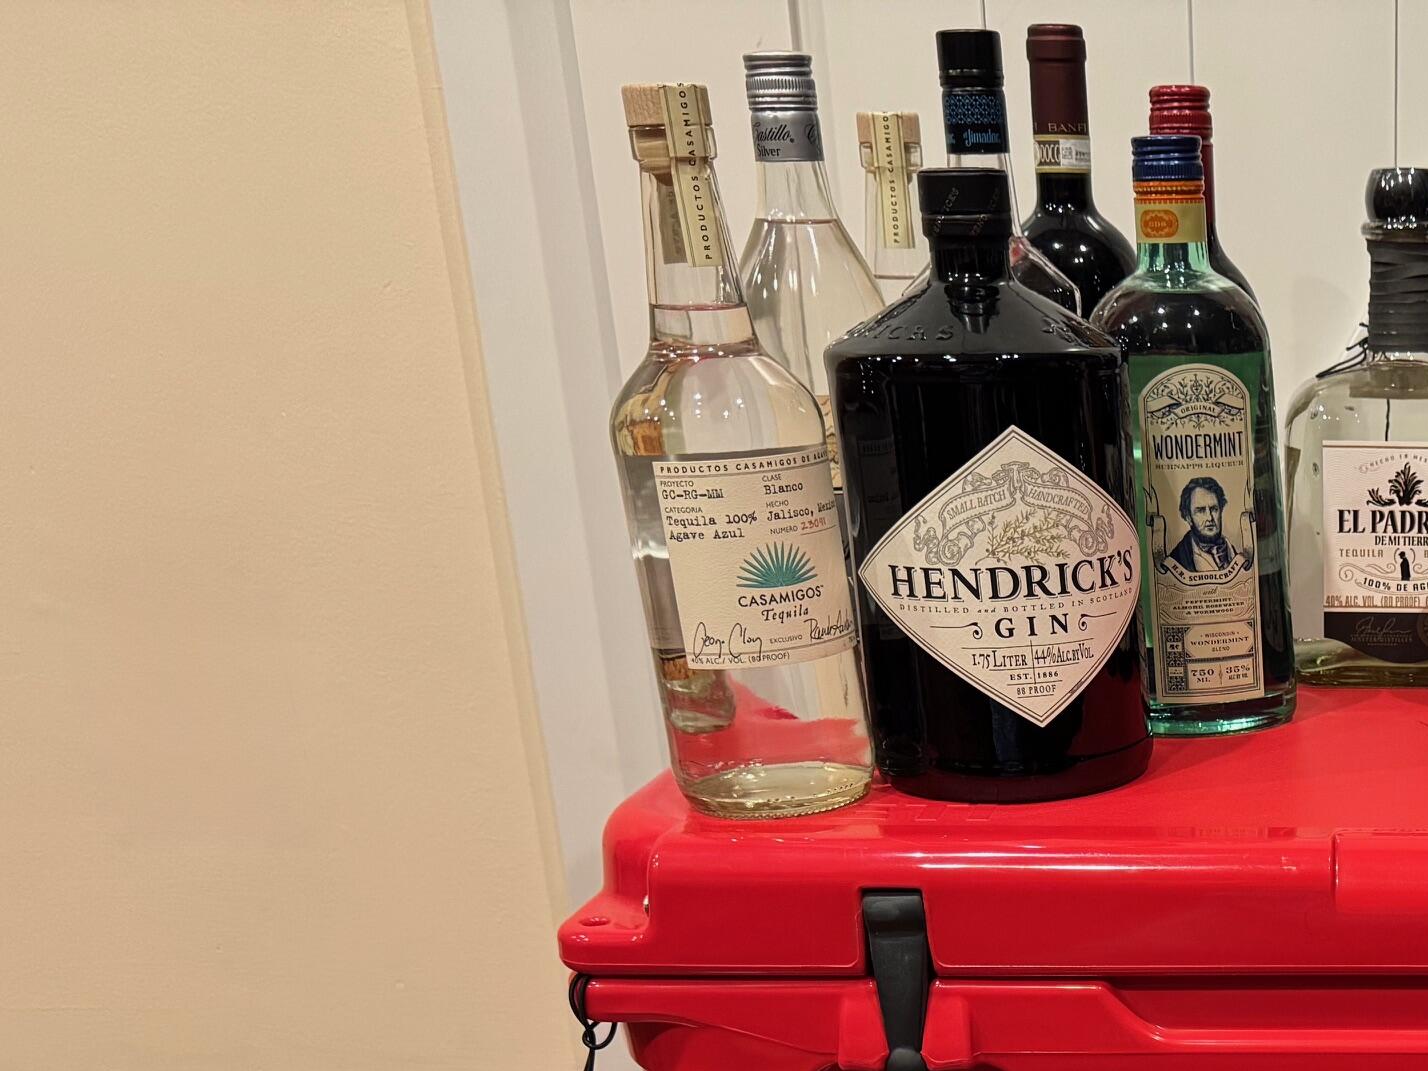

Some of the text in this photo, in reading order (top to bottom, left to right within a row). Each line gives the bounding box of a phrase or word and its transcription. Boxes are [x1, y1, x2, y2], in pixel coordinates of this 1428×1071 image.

[688, 175, 713, 260] PRODUCTOS
[889, 178, 900, 244] PRODUCTOS
[1180, 403, 1216, 414] ORIGINAL
[1152, 431, 1244, 461] WONDERMINT
[659, 457, 798, 474] PRODUCTOS CASAMIGOS
[660, 480, 694, 488] PROYECTO
[763, 481, 804, 496] Blanco
[664, 506, 703, 514] CATEGORIA
[945, 489, 1007, 519] SMALL BATCH
[1027, 487, 1091, 516] HANDCRAFTED
[666, 510, 758, 527] Tequila 100%
[766, 505, 815, 522] Jalisco,
[1337, 509, 1366, 534] EL
[669, 527, 745, 543] Agave Azul
[1339, 548, 1384, 558] TEQUILA
[888, 549, 1133, 604] HENDRICK'S
[1171, 561, 1240, 582] H.R. SCHOOLCRAFT
[1362, 576, 1391, 591] 100%
[737, 586, 821, 608] CASAMIGOS
[900, 586, 1133, 614] DISTILLED BOTTLED SCOTLAND
[761, 604, 809, 624] Tequila
[994, 614, 1069, 639] GIN
[1028, 684, 1057, 695] PROOF
